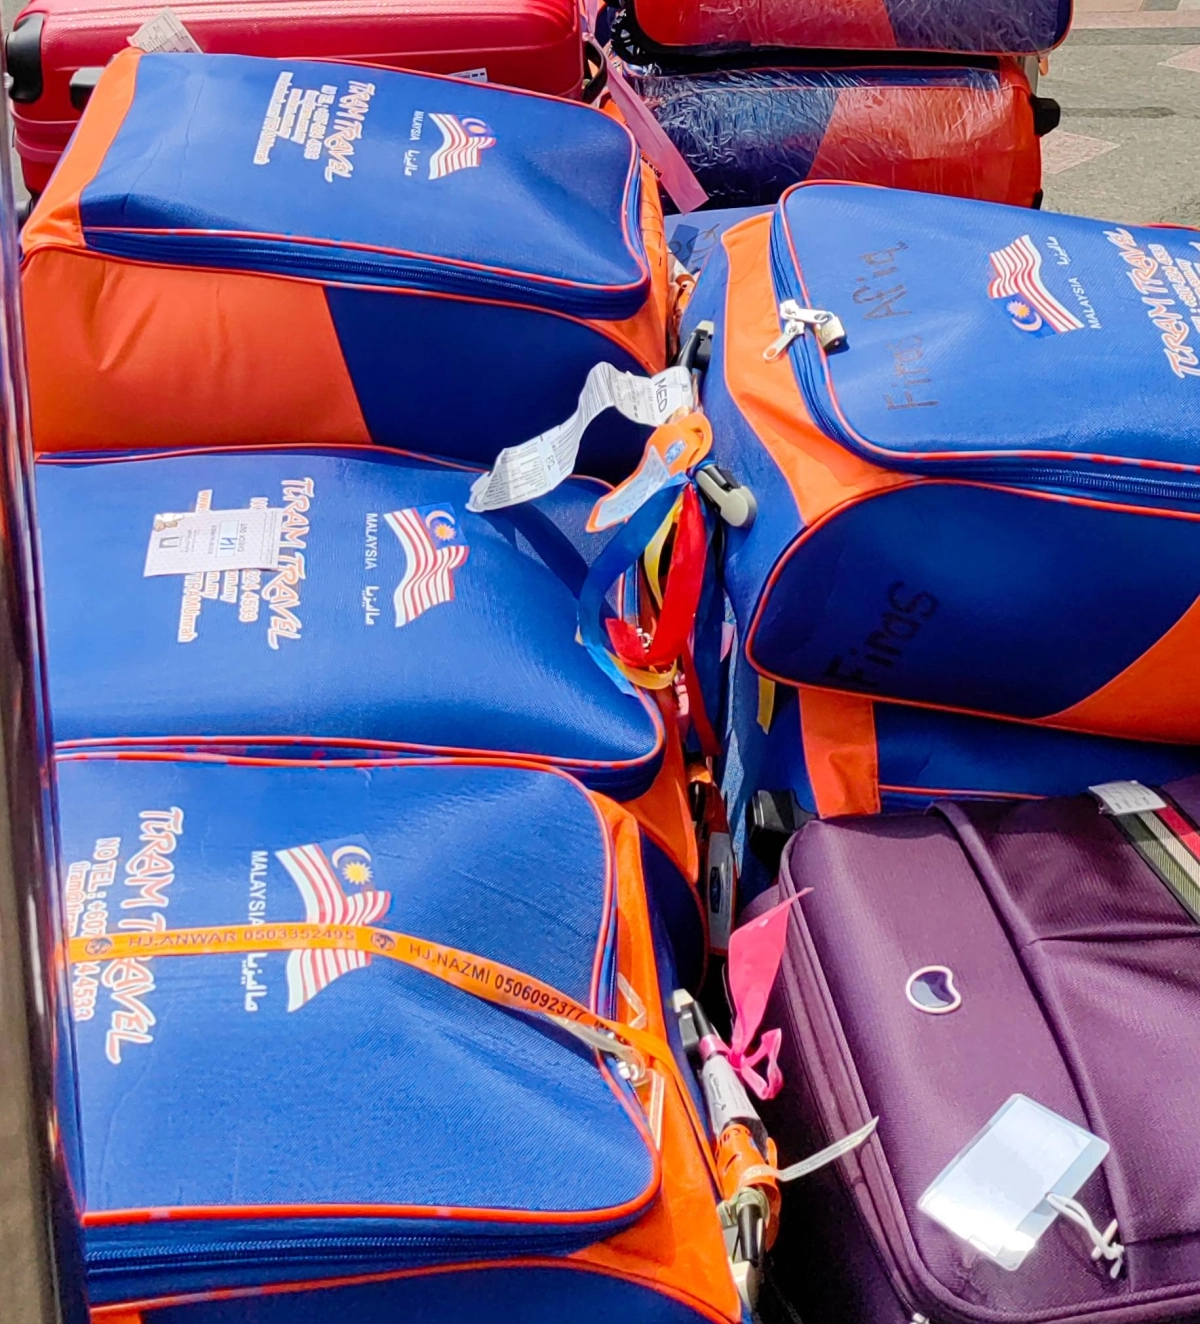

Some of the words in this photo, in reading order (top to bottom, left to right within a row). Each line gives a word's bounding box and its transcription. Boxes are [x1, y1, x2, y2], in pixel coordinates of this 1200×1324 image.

[409, 110, 425, 141] MALAYSIA
[324, 119, 362, 183] TRAVEL
[1067, 277, 1102, 330] MALAYSIA
[654, 377, 669, 412] MED
[365, 513, 378, 570] MALAYSIA
[262, 552, 305, 650] TRAVEL
[93, 837, 121, 862] NO
[243, 927, 356, 942] 0503352495
[409, 943, 490, 985] HJ.NAZMI
[104, 913, 166, 1064] TAVEL
